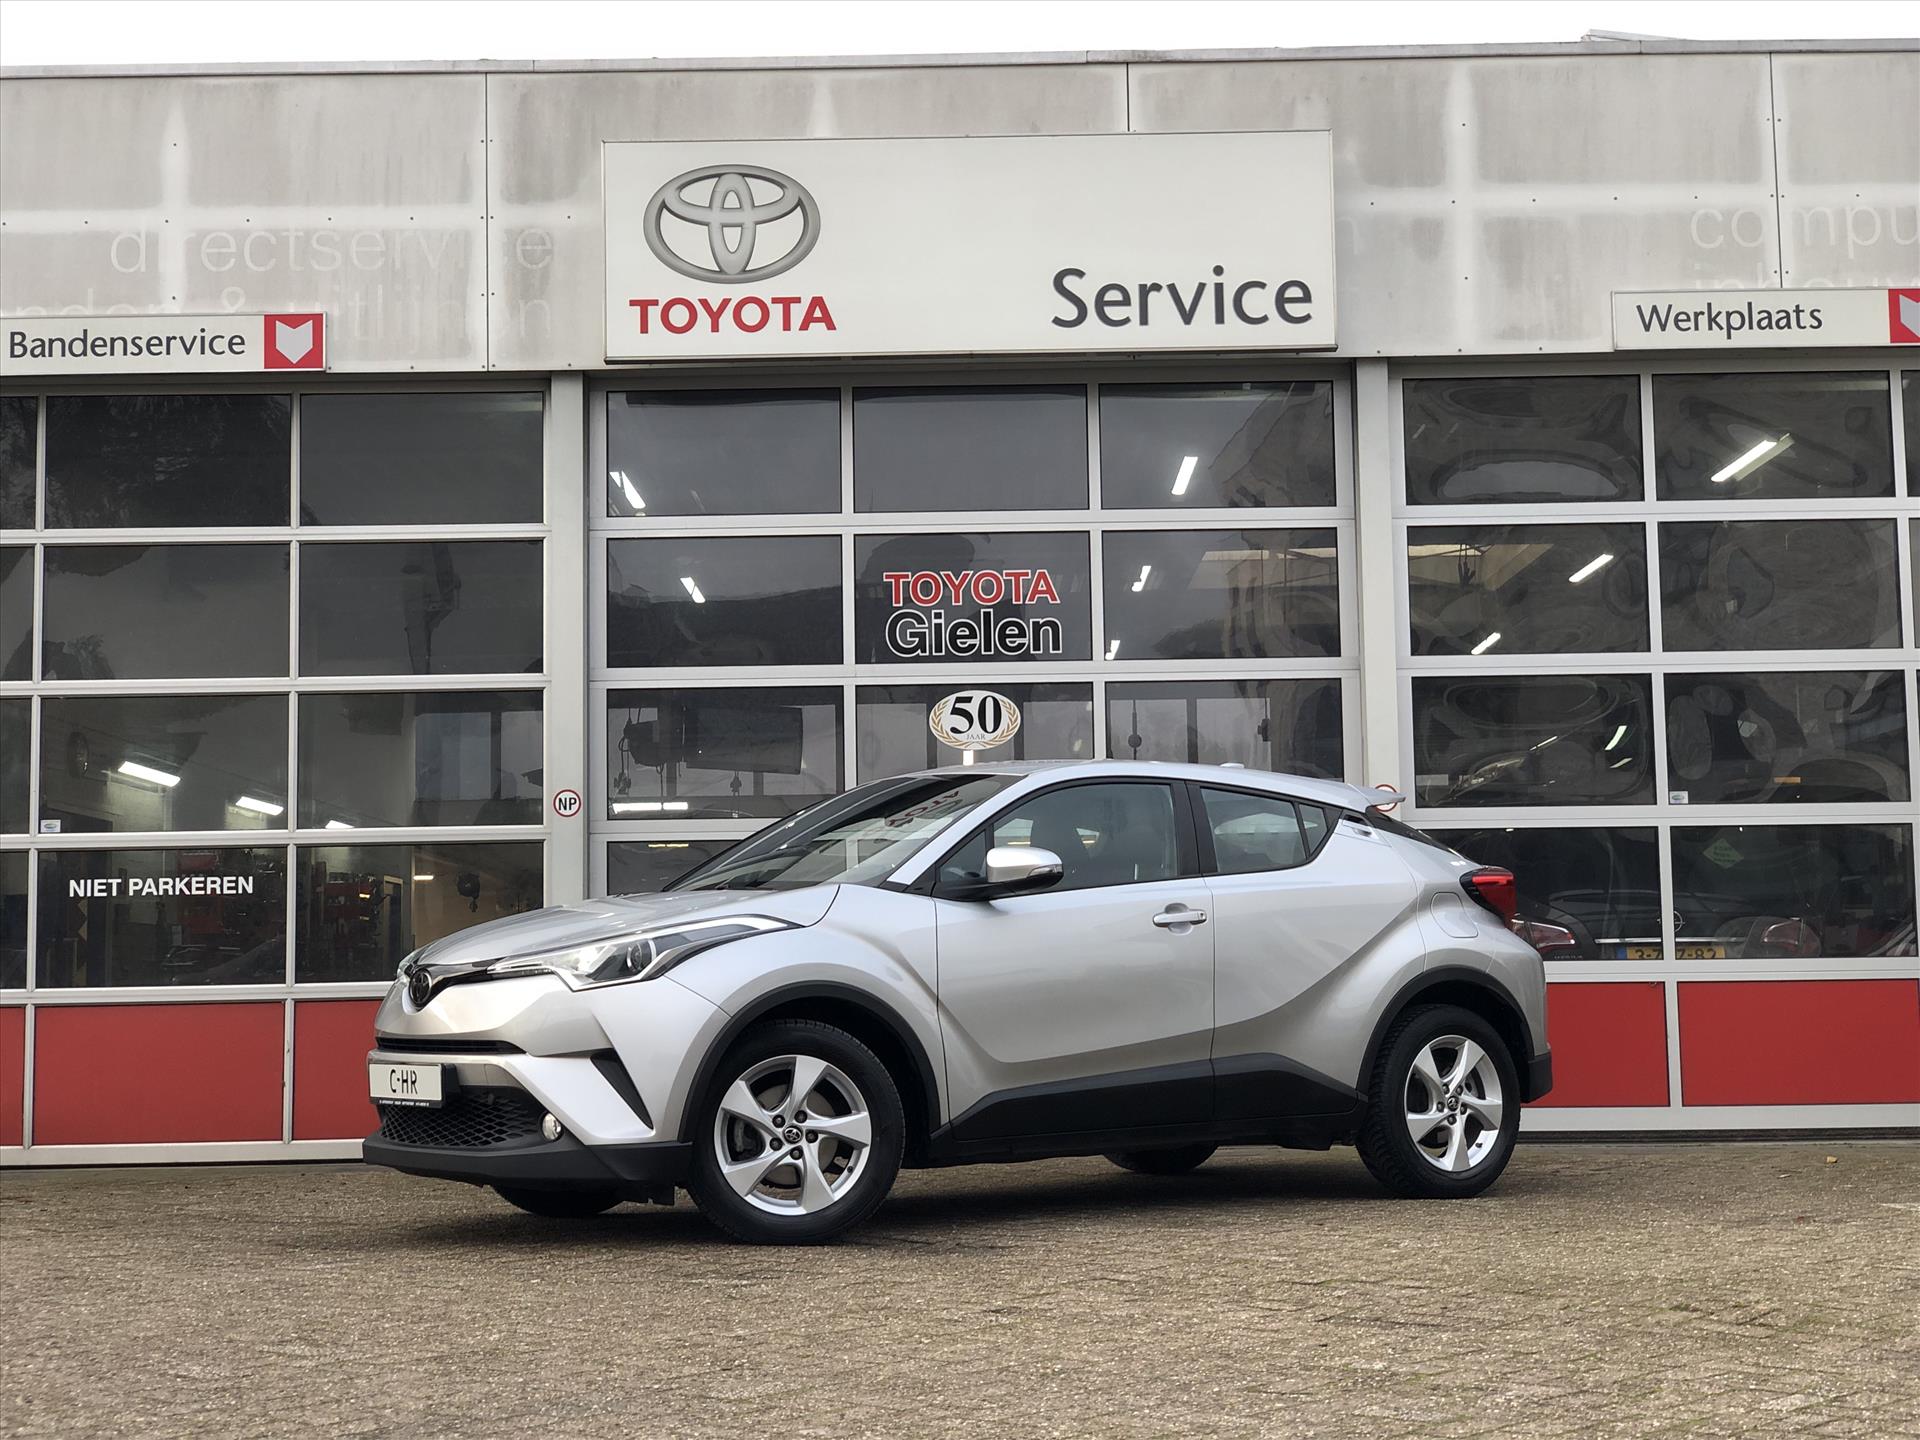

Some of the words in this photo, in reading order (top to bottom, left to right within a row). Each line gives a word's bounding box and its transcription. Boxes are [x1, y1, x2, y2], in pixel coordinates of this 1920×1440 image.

[629, 295, 837, 335] TOYOTA
[1051, 264, 1313, 329] Service
[1636, 301, 1823, 340] Werkplaats
[9, 327, 247, 359] Bandenservice
[883, 569, 1061, 607] TOYOTA
[885, 608, 1063, 658] Gielen
[950, 694, 1002, 735] 50
[966, 733, 986, 741] JAAR
[558, 797, 577, 811] NP
[69, 878, 122, 898] NIET
[128, 875, 254, 897] PARKEREN
